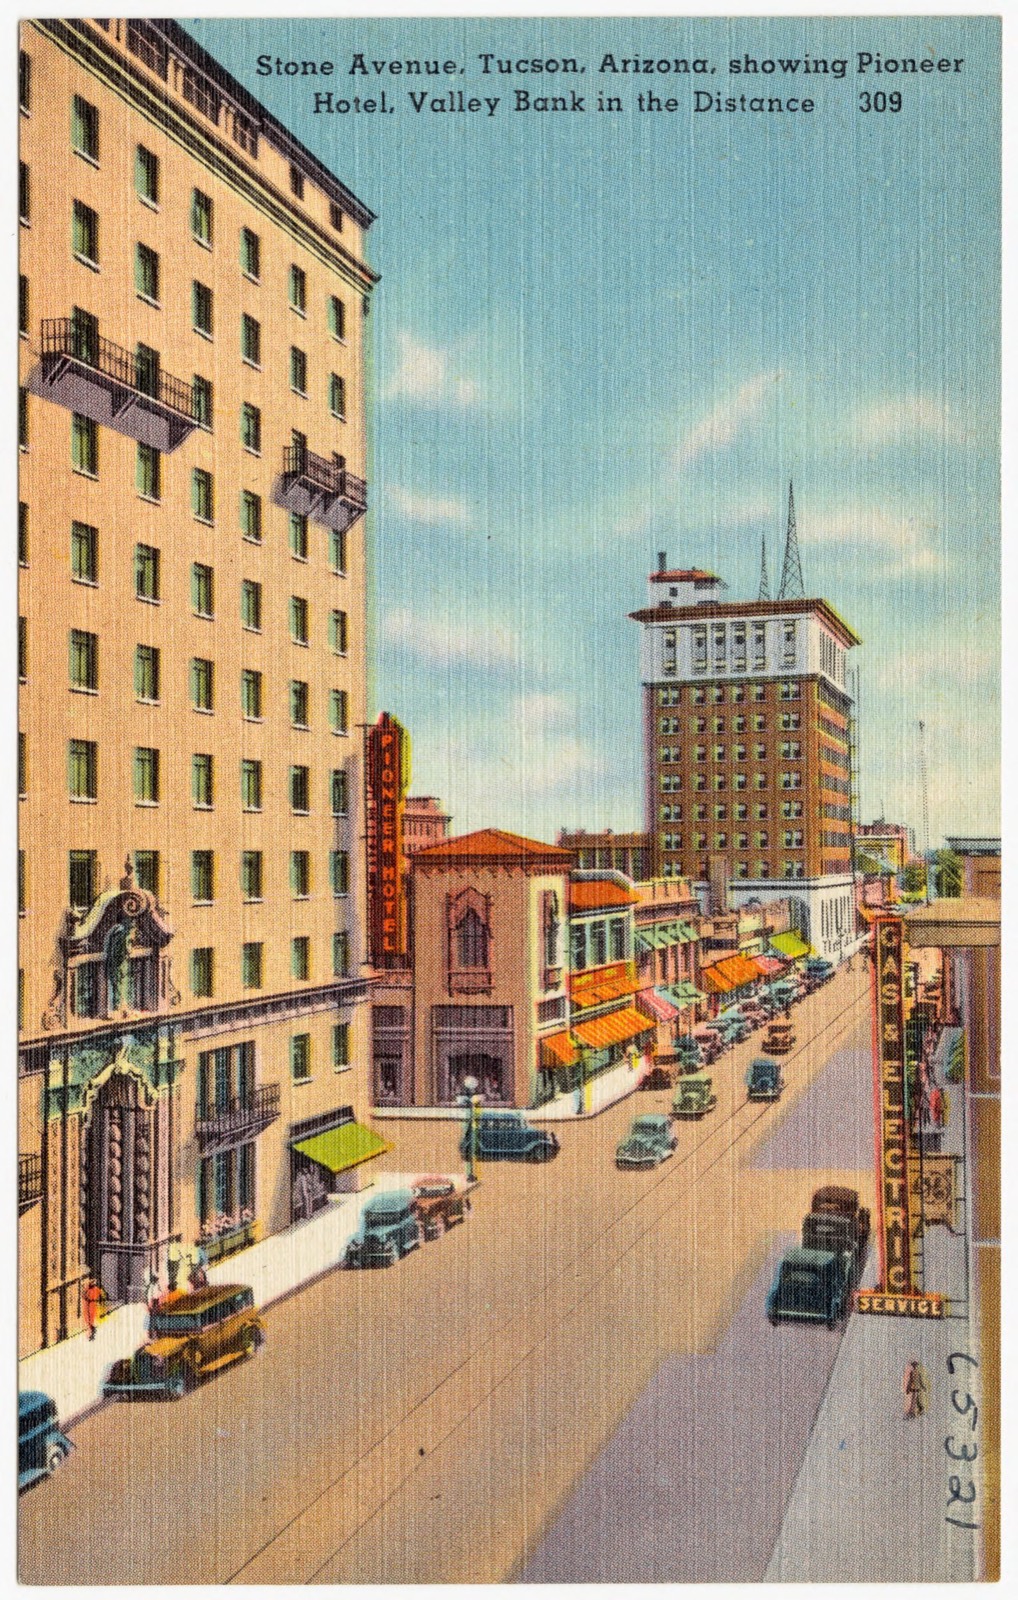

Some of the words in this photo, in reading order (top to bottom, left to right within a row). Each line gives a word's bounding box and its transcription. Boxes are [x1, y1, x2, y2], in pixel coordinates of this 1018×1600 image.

[381, 734, 394, 852] PIONEER
[381, 866, 396, 951] HOTEL
[883, 1023, 899, 1042] &
[882, 1060, 907, 1288] ELECTRIC
[859, 1297, 942, 1316] SERVICE
